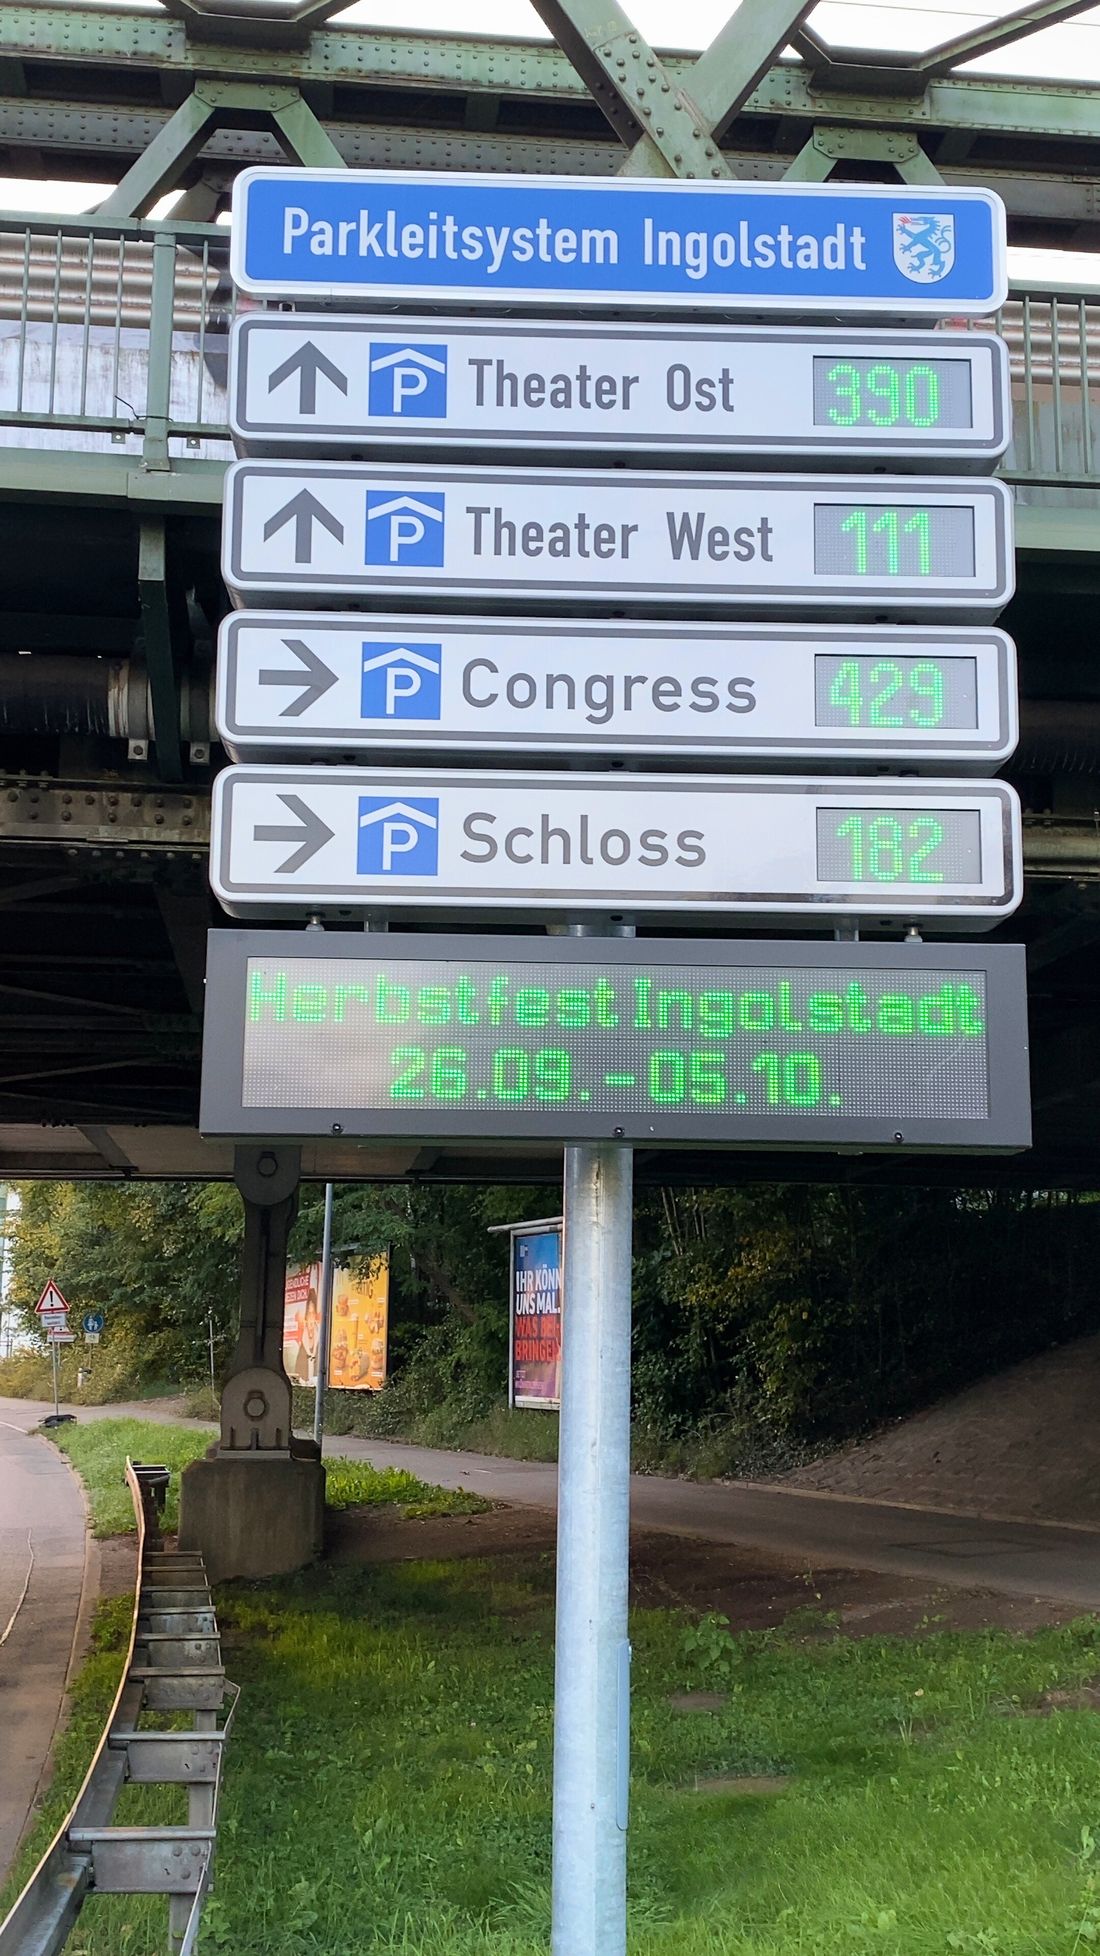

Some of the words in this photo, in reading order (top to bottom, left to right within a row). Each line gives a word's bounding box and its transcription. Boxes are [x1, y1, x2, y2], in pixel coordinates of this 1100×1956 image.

[282, 206, 618, 274] Parkleitsystem
[643, 217, 867, 281] Ingolstadt
[392, 366, 429, 414] P
[467, 358, 640, 411] Theater
[666, 363, 735, 413] Ost
[827, 364, 941, 427] 390
[389, 515, 426, 563] P
[465, 506, 639, 560] Theater
[666, 511, 774, 563] West
[841, 510, 933, 575] 111
[385, 667, 423, 717] P
[462, 657, 757, 725] Congress
[829, 660, 945, 727] 429
[381, 821, 419, 872] P
[459, 812, 706, 868] Schloss
[835, 815, 945, 883] 182
[249, 970, 620, 1028] Herbstfest
[633, 976, 984, 1040] Ingolstadt
[516, 1271, 535, 1292] IHR
[516, 1292, 535, 1315] UNS
